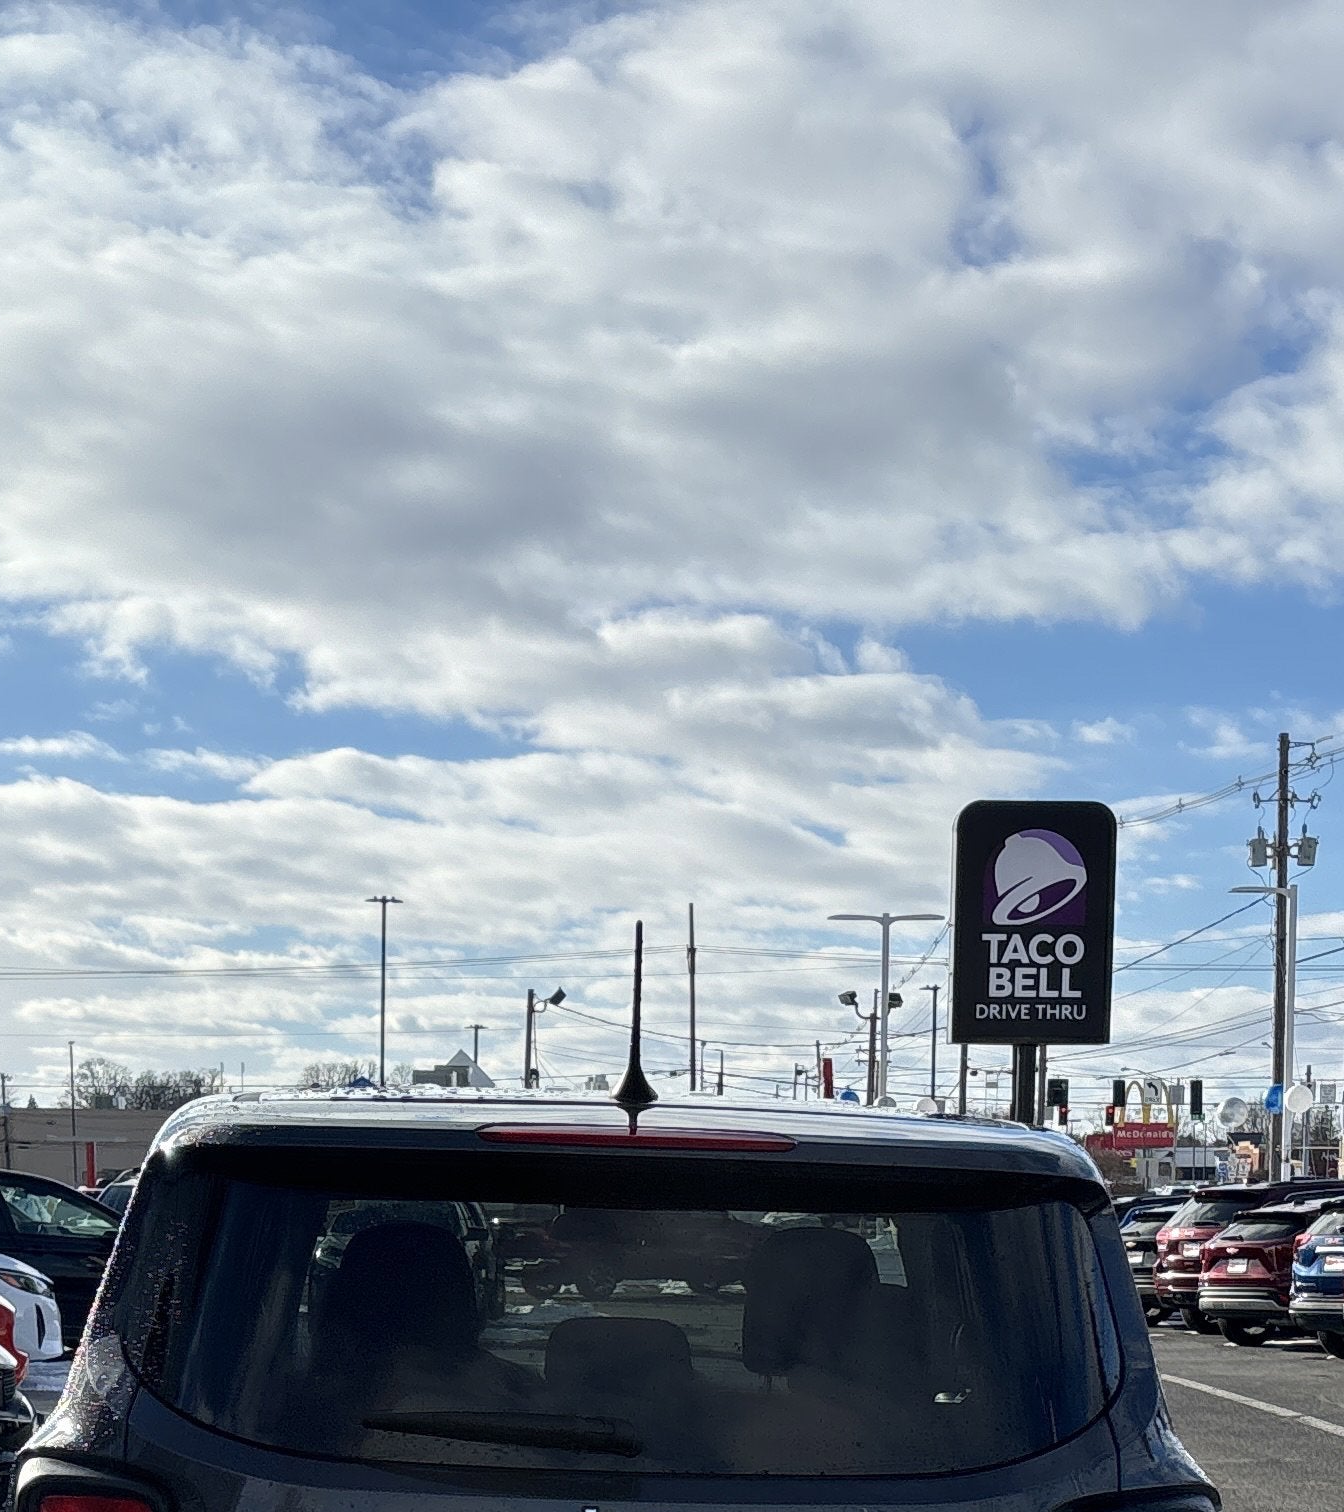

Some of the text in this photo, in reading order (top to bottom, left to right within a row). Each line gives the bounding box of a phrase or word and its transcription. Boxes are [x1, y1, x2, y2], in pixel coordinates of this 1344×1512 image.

[981, 933, 1085, 965] TACO
[988, 967, 1082, 998] BELL
[976, 1003, 1087, 1020] DRIVE THRU
